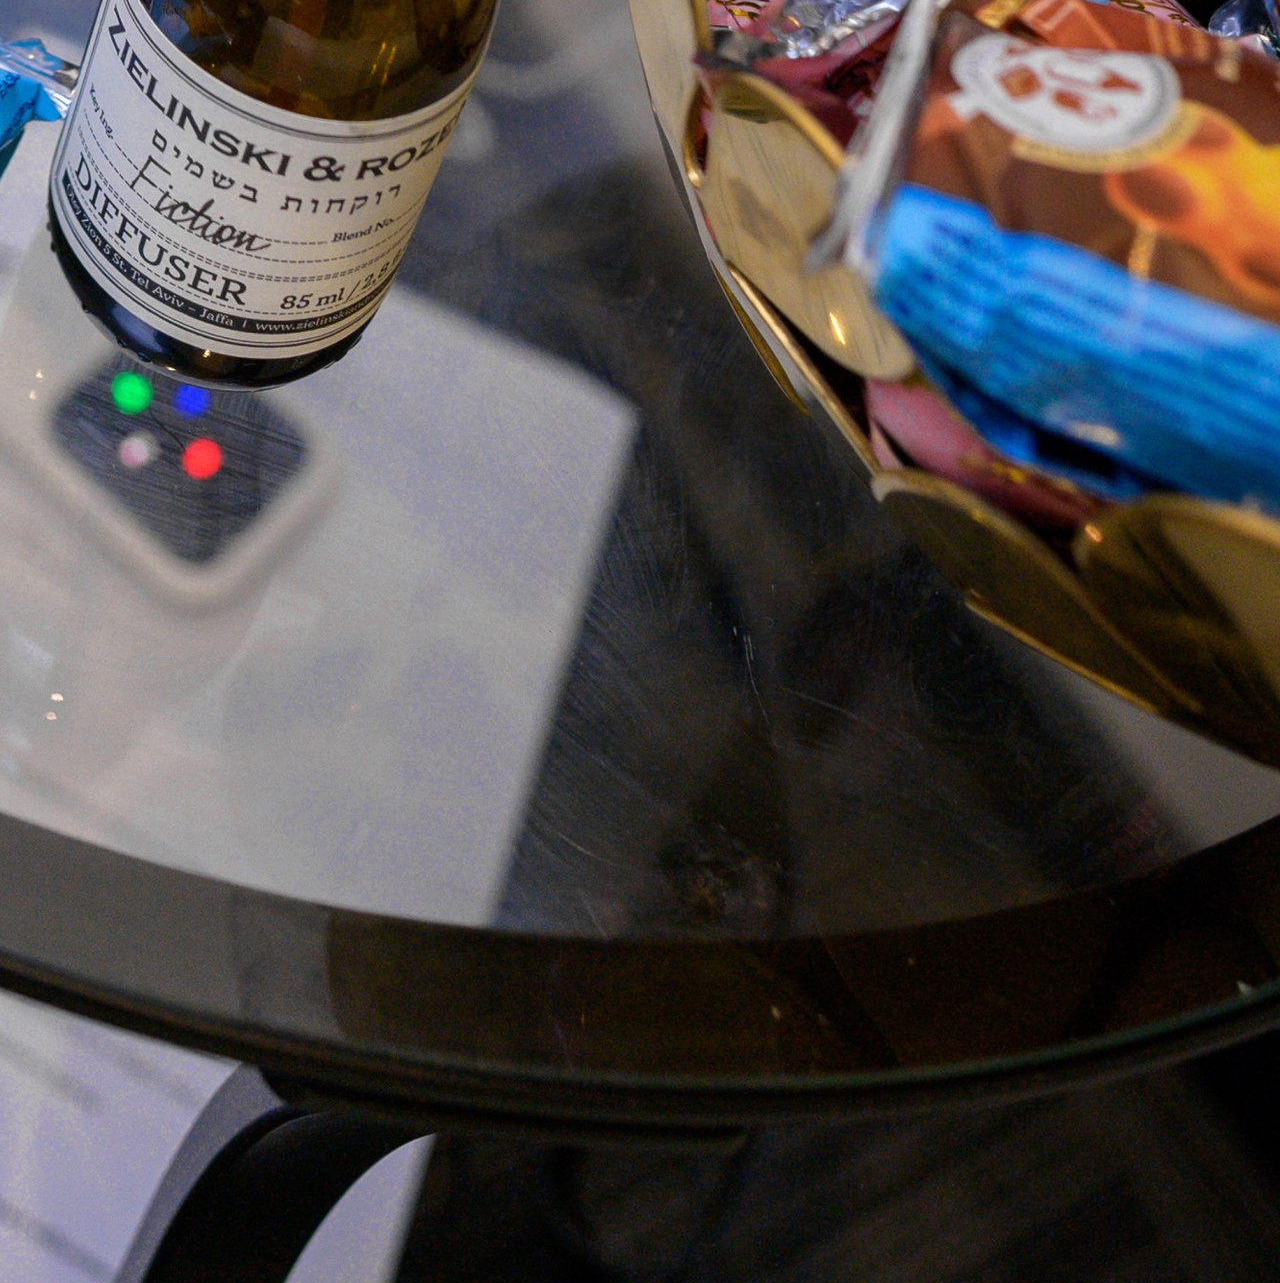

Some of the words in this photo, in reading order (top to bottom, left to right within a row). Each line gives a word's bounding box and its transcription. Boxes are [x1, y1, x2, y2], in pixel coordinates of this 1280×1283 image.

[108, 4, 291, 176] ZIELINSKI
[304, 156, 346, 182] &
[129, 155, 271, 252] Fiction
[152, 128, 259, 203] בשמים
[280, 184, 401, 216] רוקחות
[75, 151, 247, 306] DIFFUSER
[80, 214, 102, 248] Zion
[103, 245, 112, 255] 5
[112, 252, 128, 274] St.
[130, 268, 150, 290] Tel
[151, 286, 185, 308] Aviv
[199, 308, 234, 327] Jaffa
[331, 225, 373, 243] Blend
[280, 293, 314, 310] 85
[315, 287, 345, 307] ml
